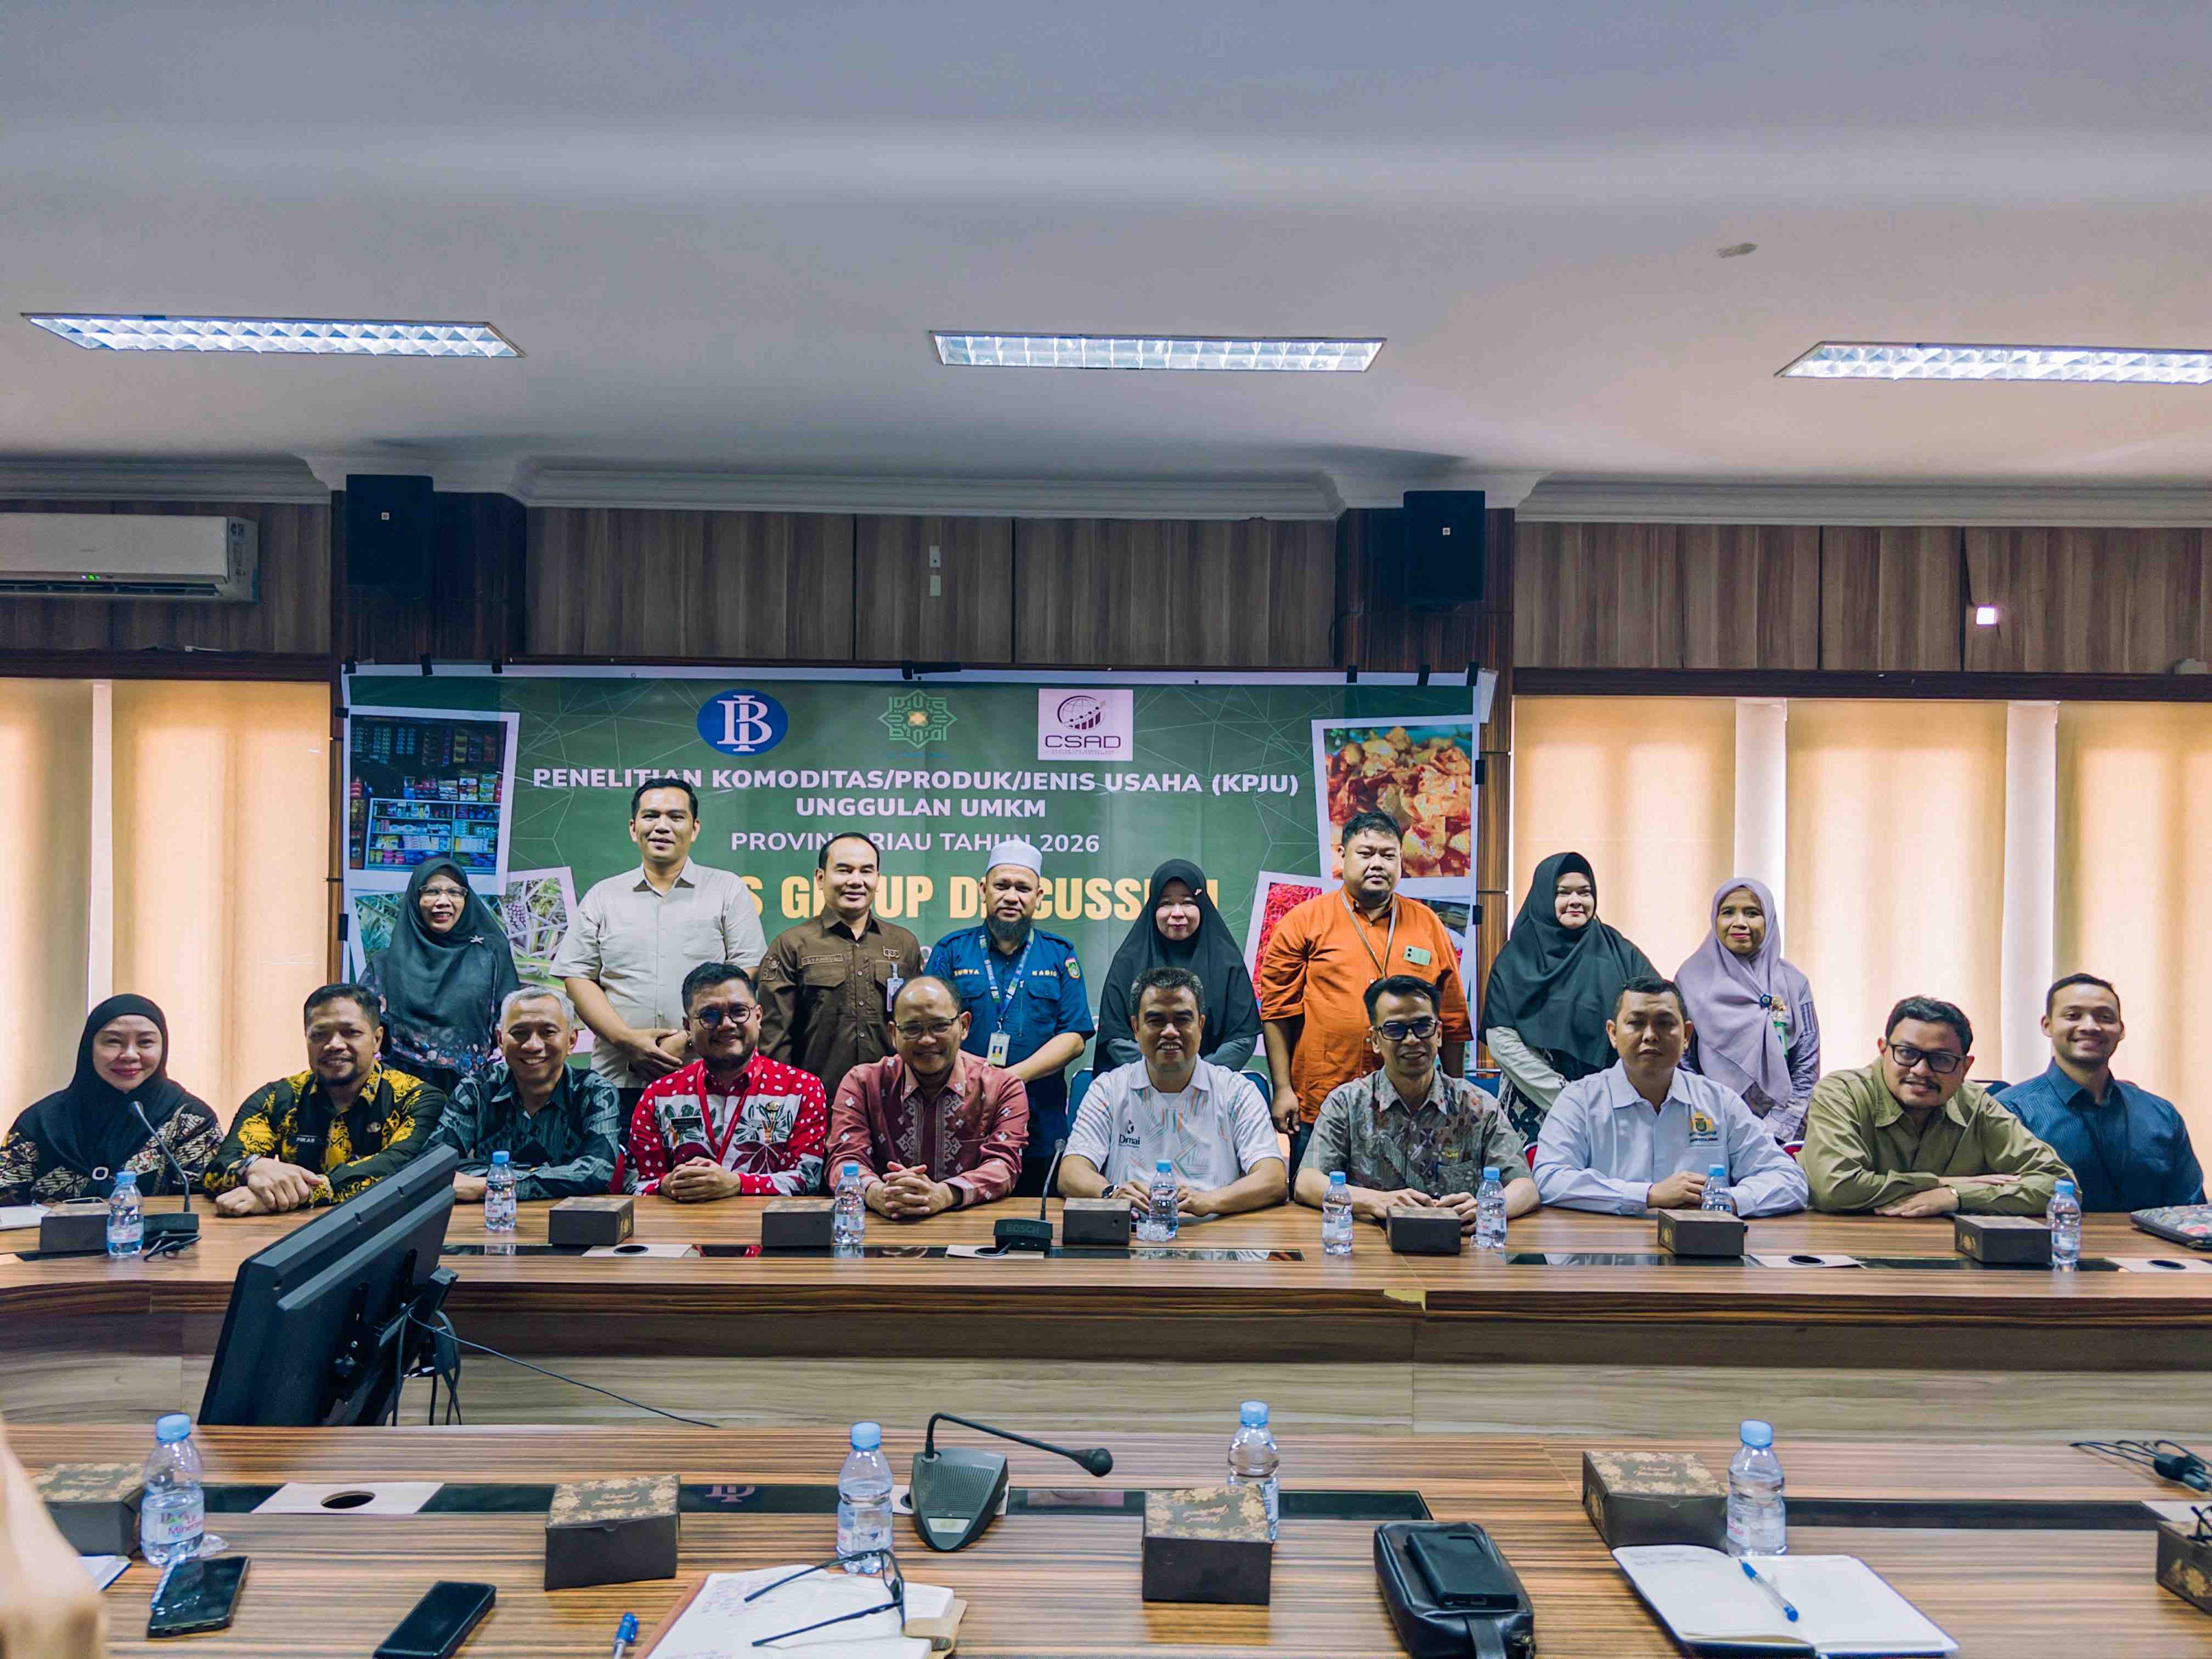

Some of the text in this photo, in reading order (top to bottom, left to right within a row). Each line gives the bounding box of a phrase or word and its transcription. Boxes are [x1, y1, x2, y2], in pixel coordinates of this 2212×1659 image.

[1045, 735, 1121, 748] CSAD
[533, 769, 1299, 796] PENELITIAN KOMODITAS/PRODUK/JENIS USAHA (KPJU)
[796, 798, 1046, 817] UNGGULAN UMKM
[731, 832, 833, 851] PROVIN
[868, 833, 932, 851] RIAU
[1040, 834, 1099, 853] 2026
[781, 876, 934, 919] GUP
[949, 876, 1218, 921] DCUSS
